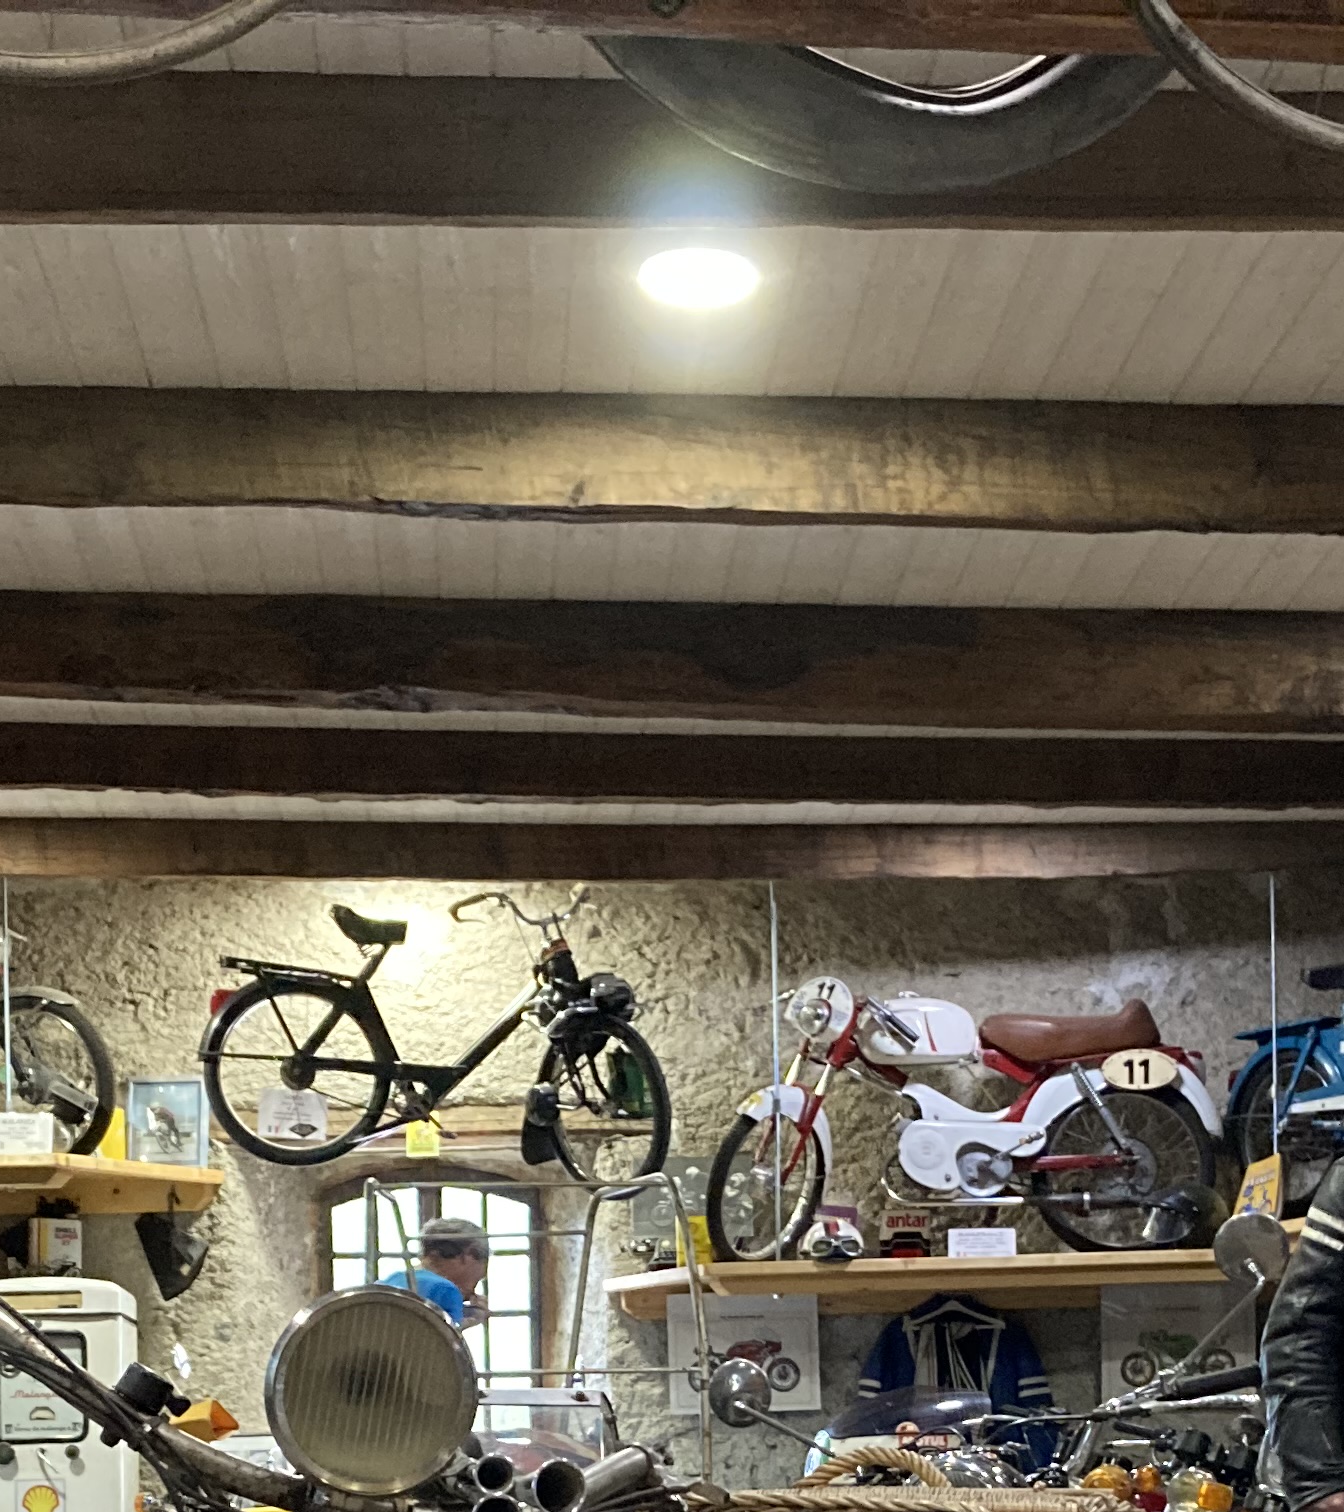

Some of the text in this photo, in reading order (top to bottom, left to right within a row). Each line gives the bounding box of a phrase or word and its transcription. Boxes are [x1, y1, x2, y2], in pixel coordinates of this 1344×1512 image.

[818, 982, 836, 1000] 11
[1123, 1058, 1149, 1084] 11
[886, 1213, 927, 1229] antar
